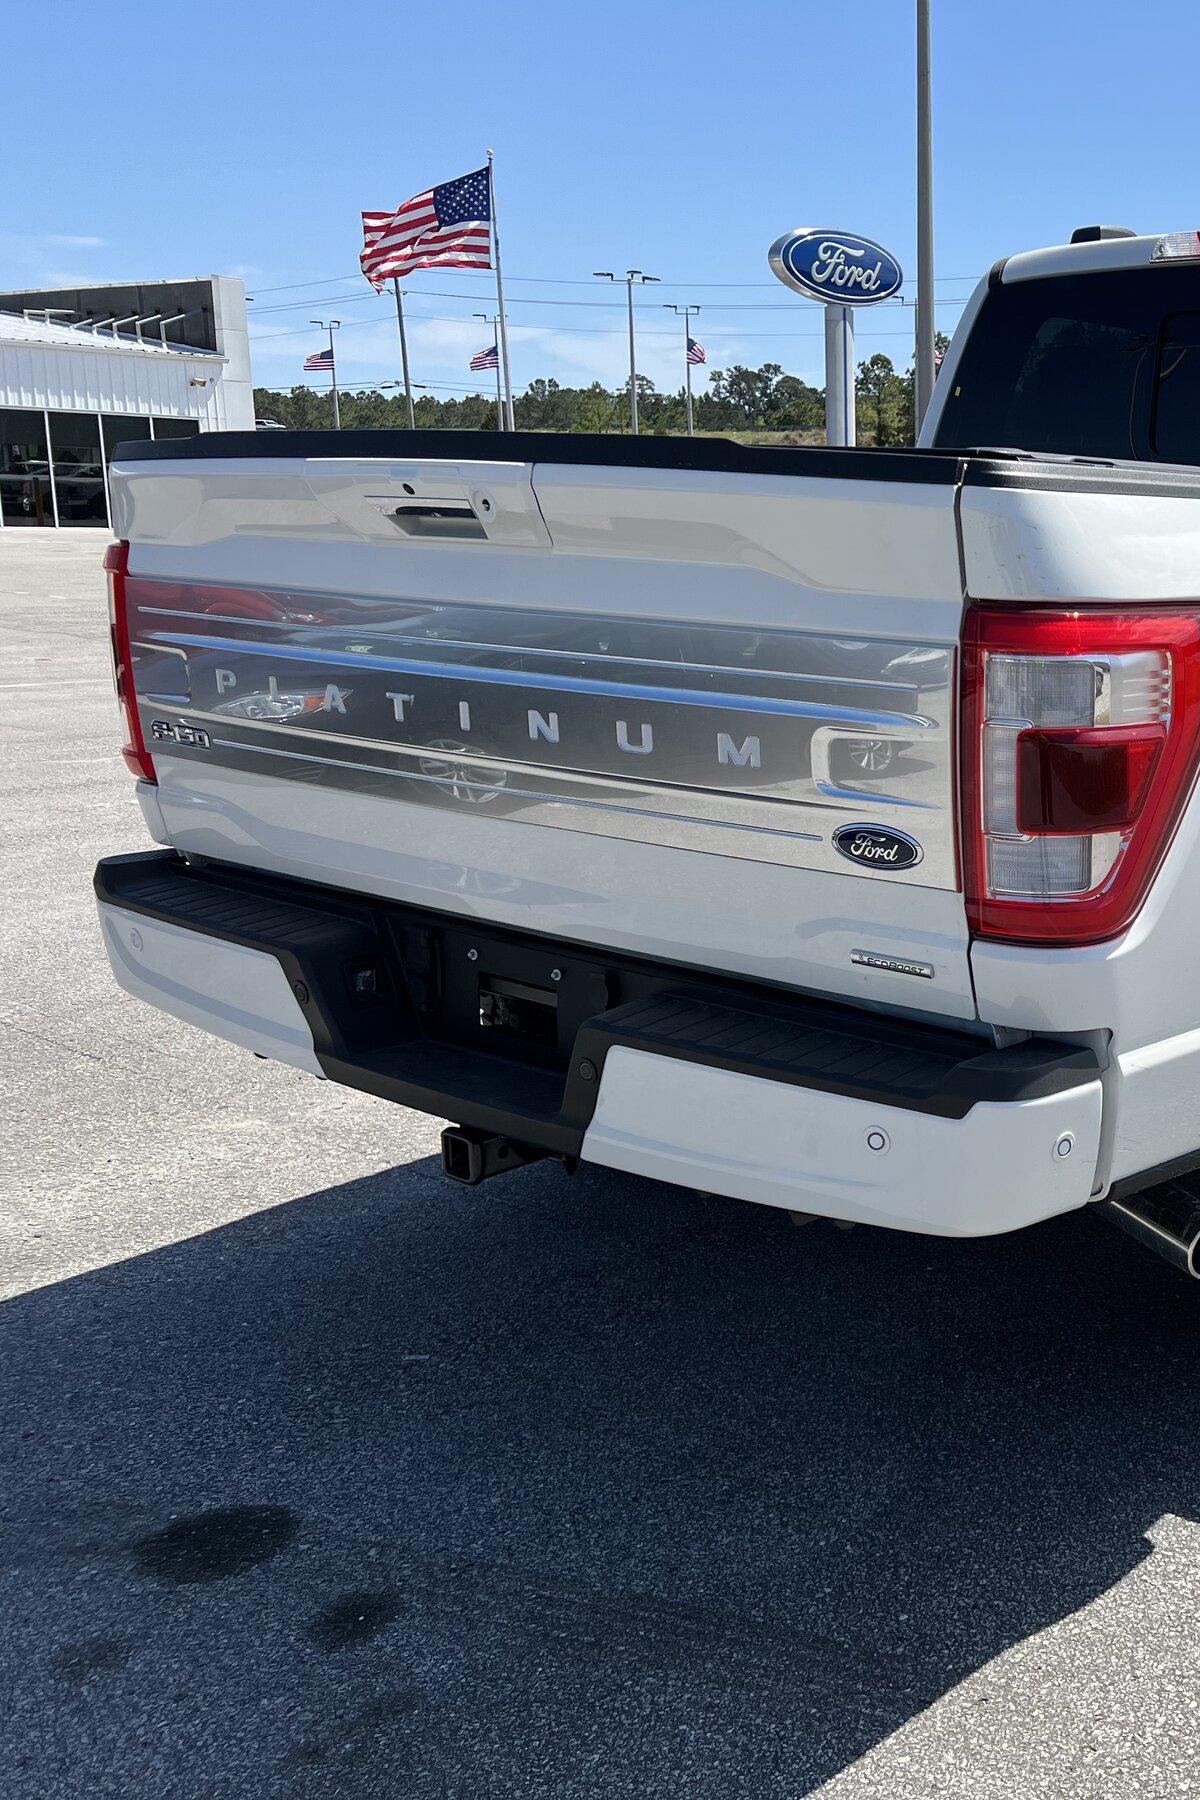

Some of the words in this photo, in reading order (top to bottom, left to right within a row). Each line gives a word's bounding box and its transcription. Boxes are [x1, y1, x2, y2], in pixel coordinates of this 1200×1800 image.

[810, 241, 882, 291] Ford
[151, 720, 211, 750] F-150
[214, 668, 763, 768] PLATINUM
[850, 833, 899, 862] Ford
